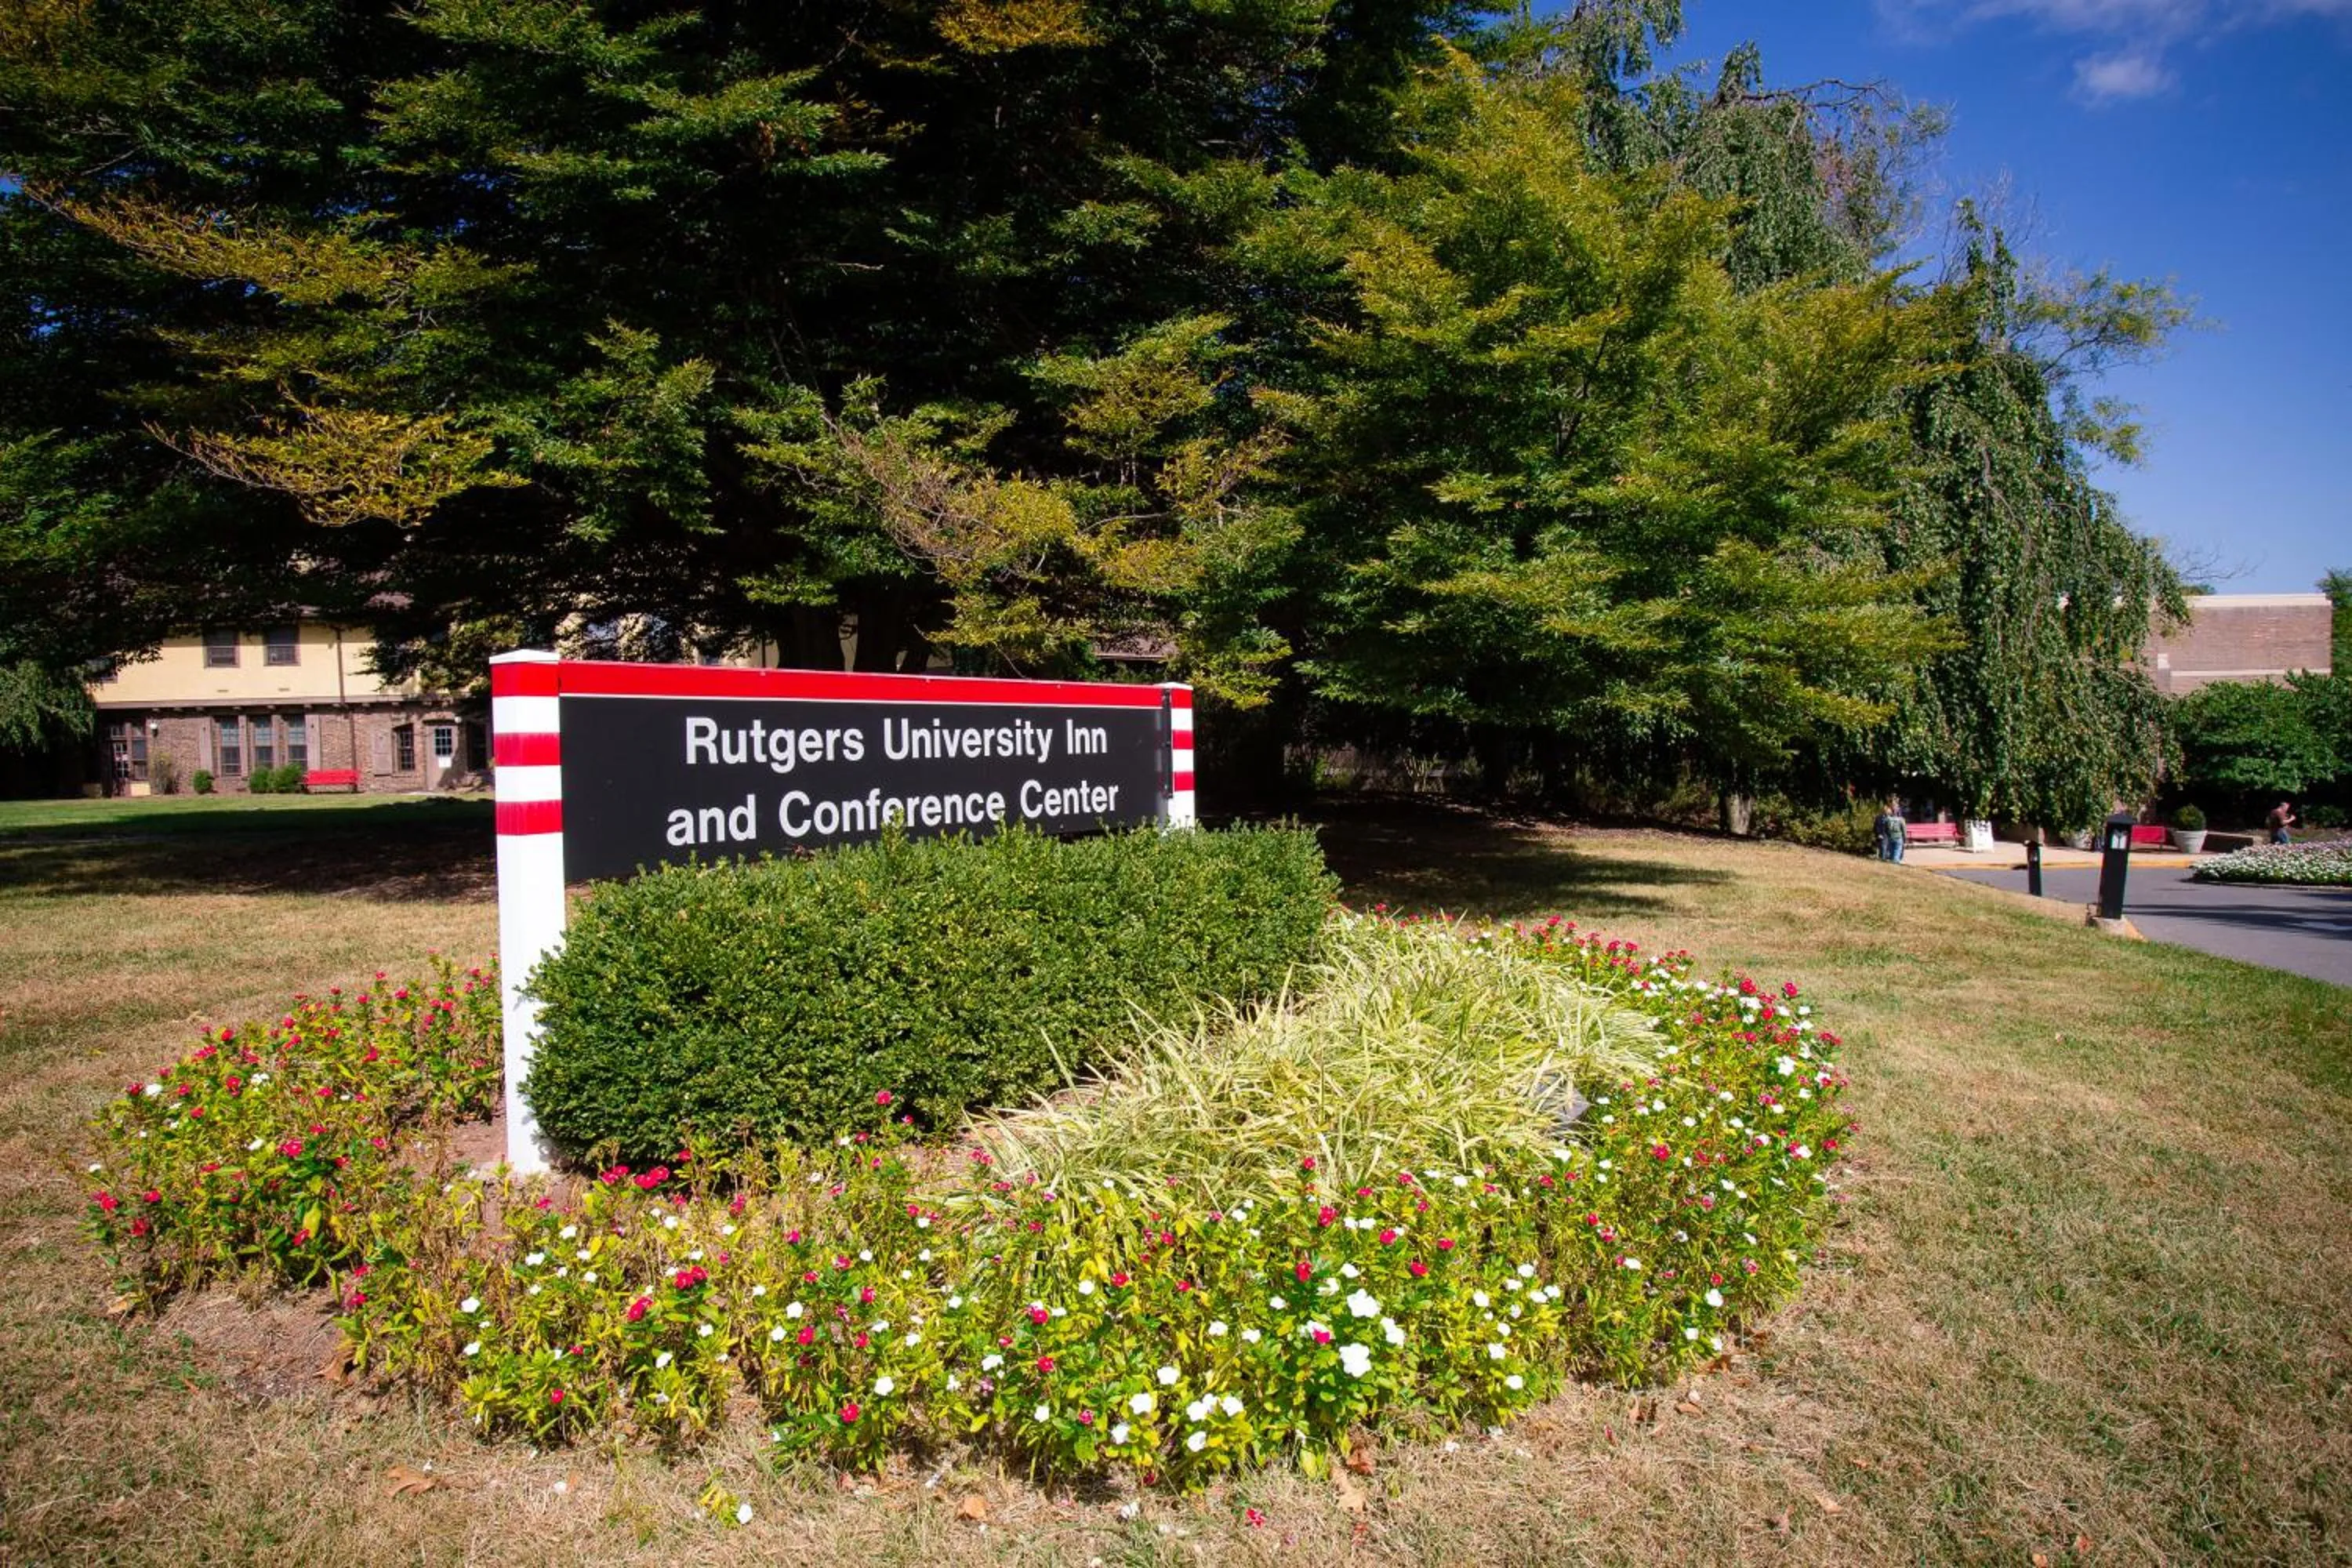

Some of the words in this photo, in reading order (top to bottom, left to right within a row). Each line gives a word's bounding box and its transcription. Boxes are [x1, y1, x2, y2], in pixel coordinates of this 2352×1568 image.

[685, 716, 864, 773] Rutgers
[884, 717, 1052, 764] University
[1065, 719, 1107, 755] Inn
[666, 793, 757, 847] and
[779, 787, 1006, 838] Conference
[1020, 779, 1119, 818] Center
